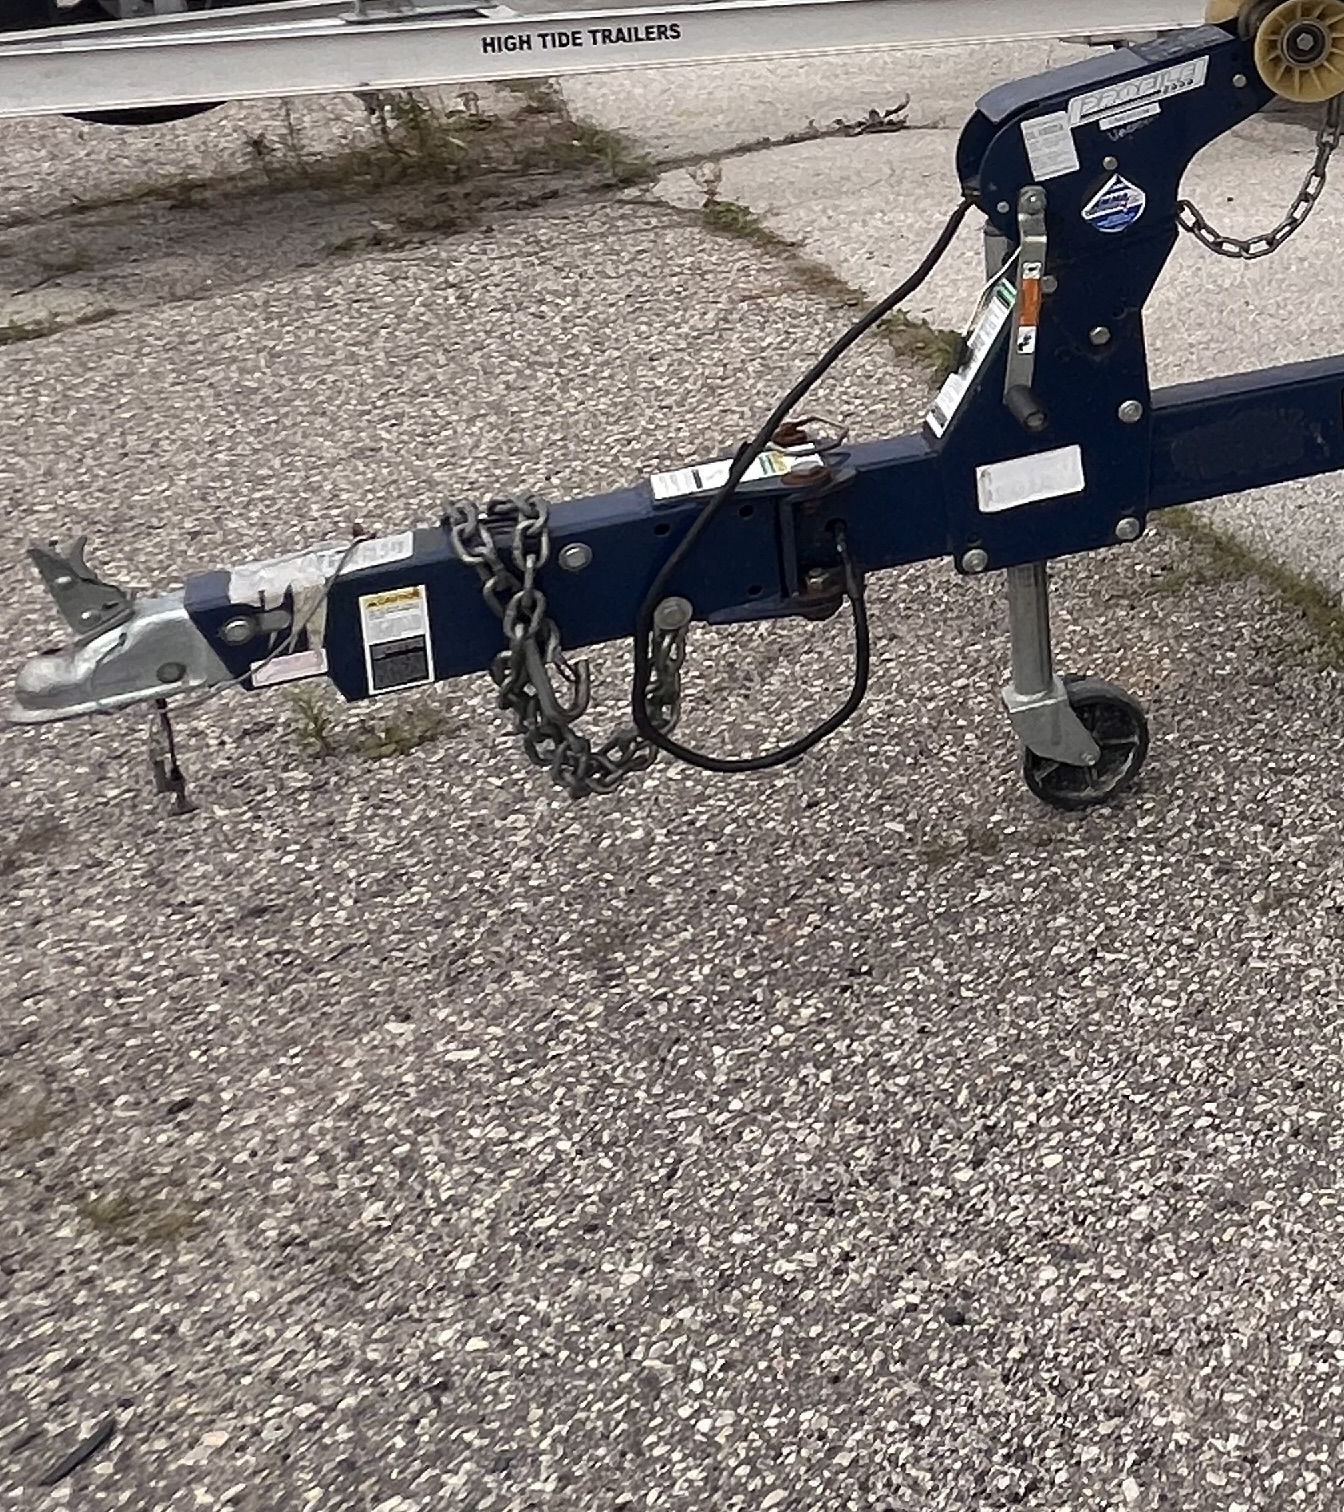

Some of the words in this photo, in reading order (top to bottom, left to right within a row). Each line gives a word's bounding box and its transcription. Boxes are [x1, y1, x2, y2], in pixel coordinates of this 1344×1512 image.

[481, 34, 532, 54] HIGH
[537, 30, 583, 50] TIDE
[587, 23, 681, 46] TRAILERS
